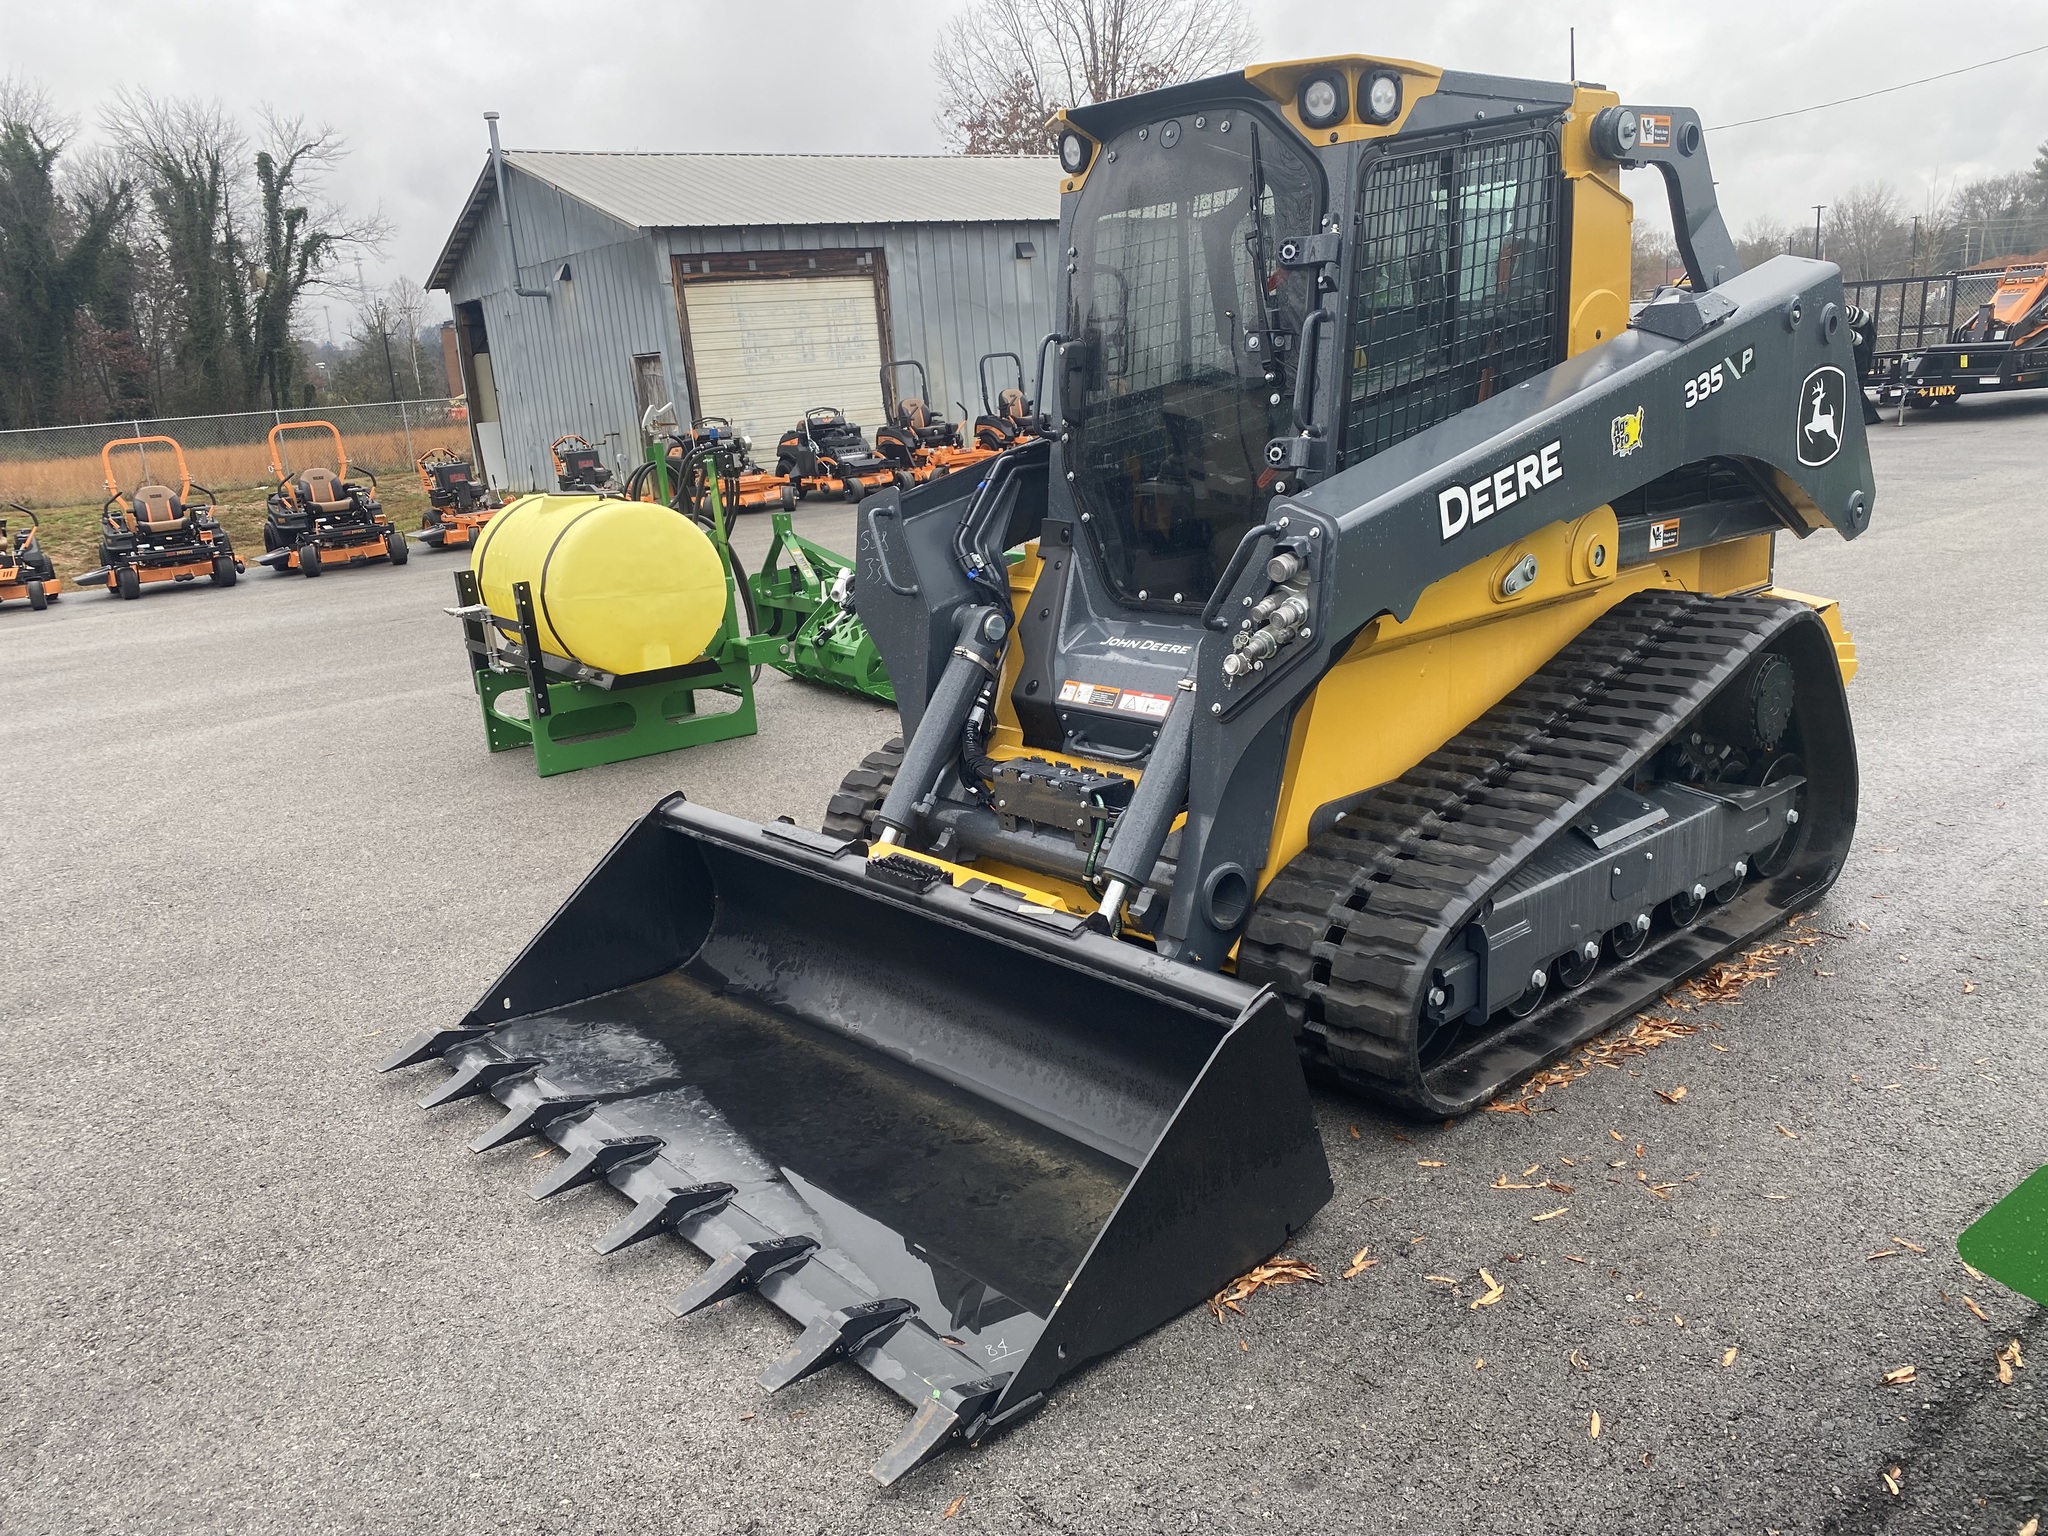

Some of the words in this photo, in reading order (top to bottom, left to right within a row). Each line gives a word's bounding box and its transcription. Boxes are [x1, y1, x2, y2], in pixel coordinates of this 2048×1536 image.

[1684, 363, 1723, 408] 335
[1929, 385, 1956, 397] LINX
[1438, 440, 1562, 540] DEERE
[1100, 636, 1141, 649] JOHN
[1140, 639, 1192, 655] DEERE
